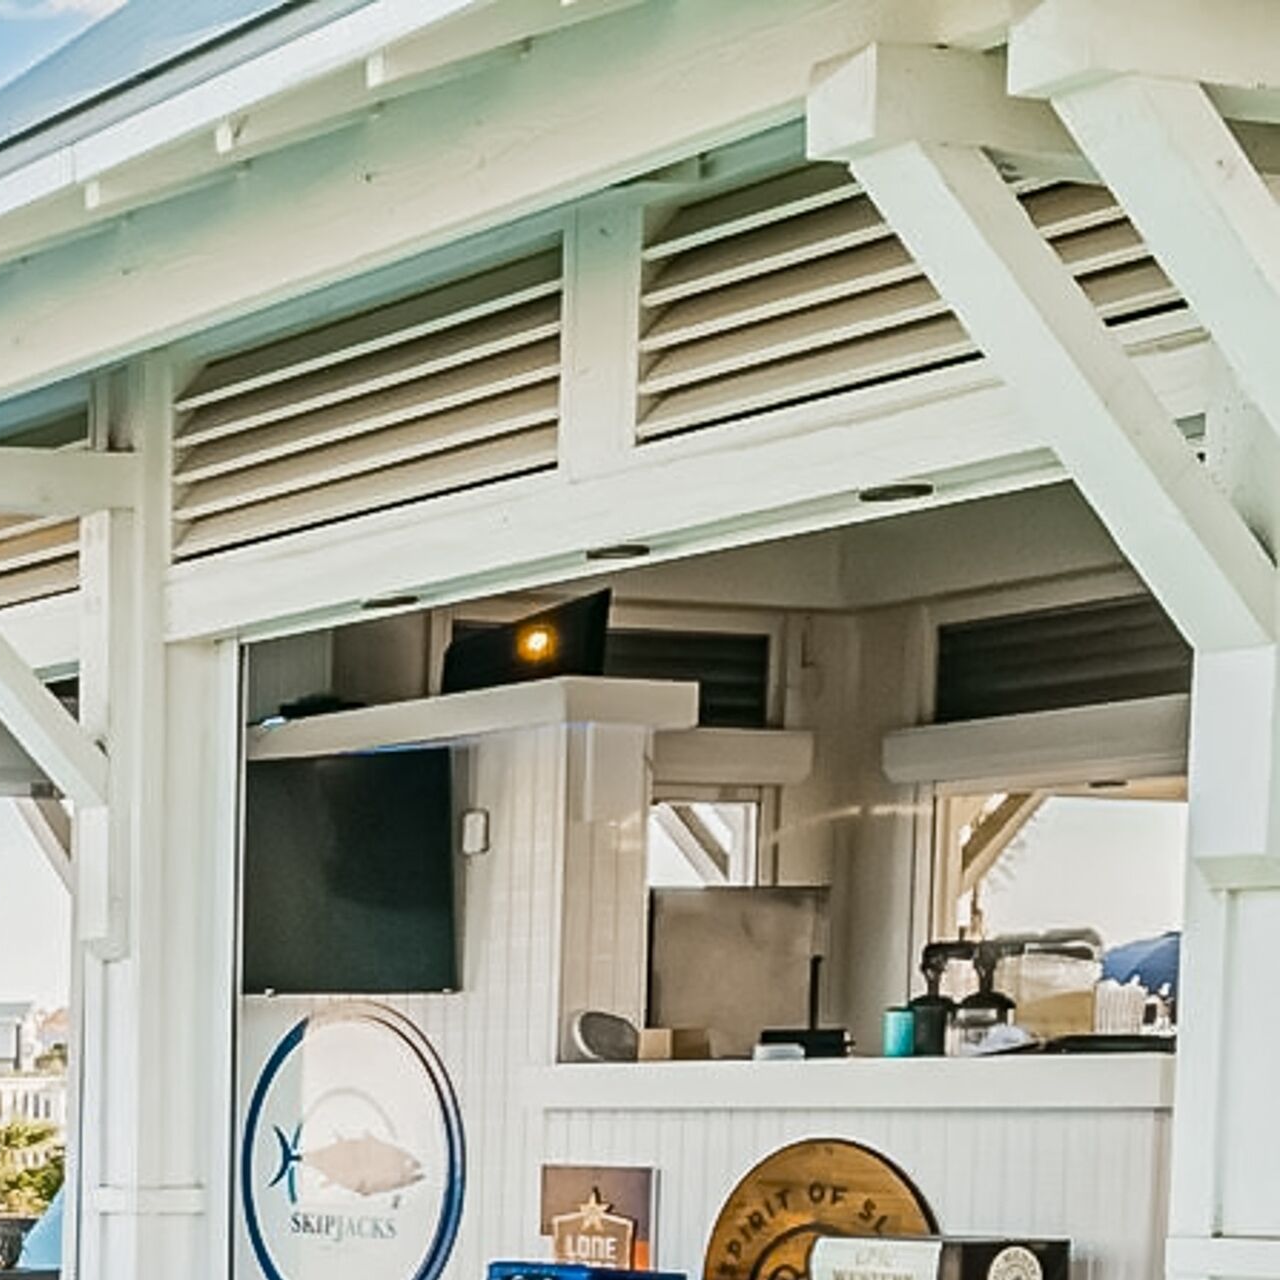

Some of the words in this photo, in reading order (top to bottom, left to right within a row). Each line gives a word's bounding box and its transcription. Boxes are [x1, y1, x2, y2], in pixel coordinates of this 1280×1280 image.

[290, 1212, 397, 1242] SKIPJACKS
[716, 1187, 791, 1277] SPIRIT
[808, 1181, 848, 1205] OF
[565, 1234, 618, 1260] LONE
